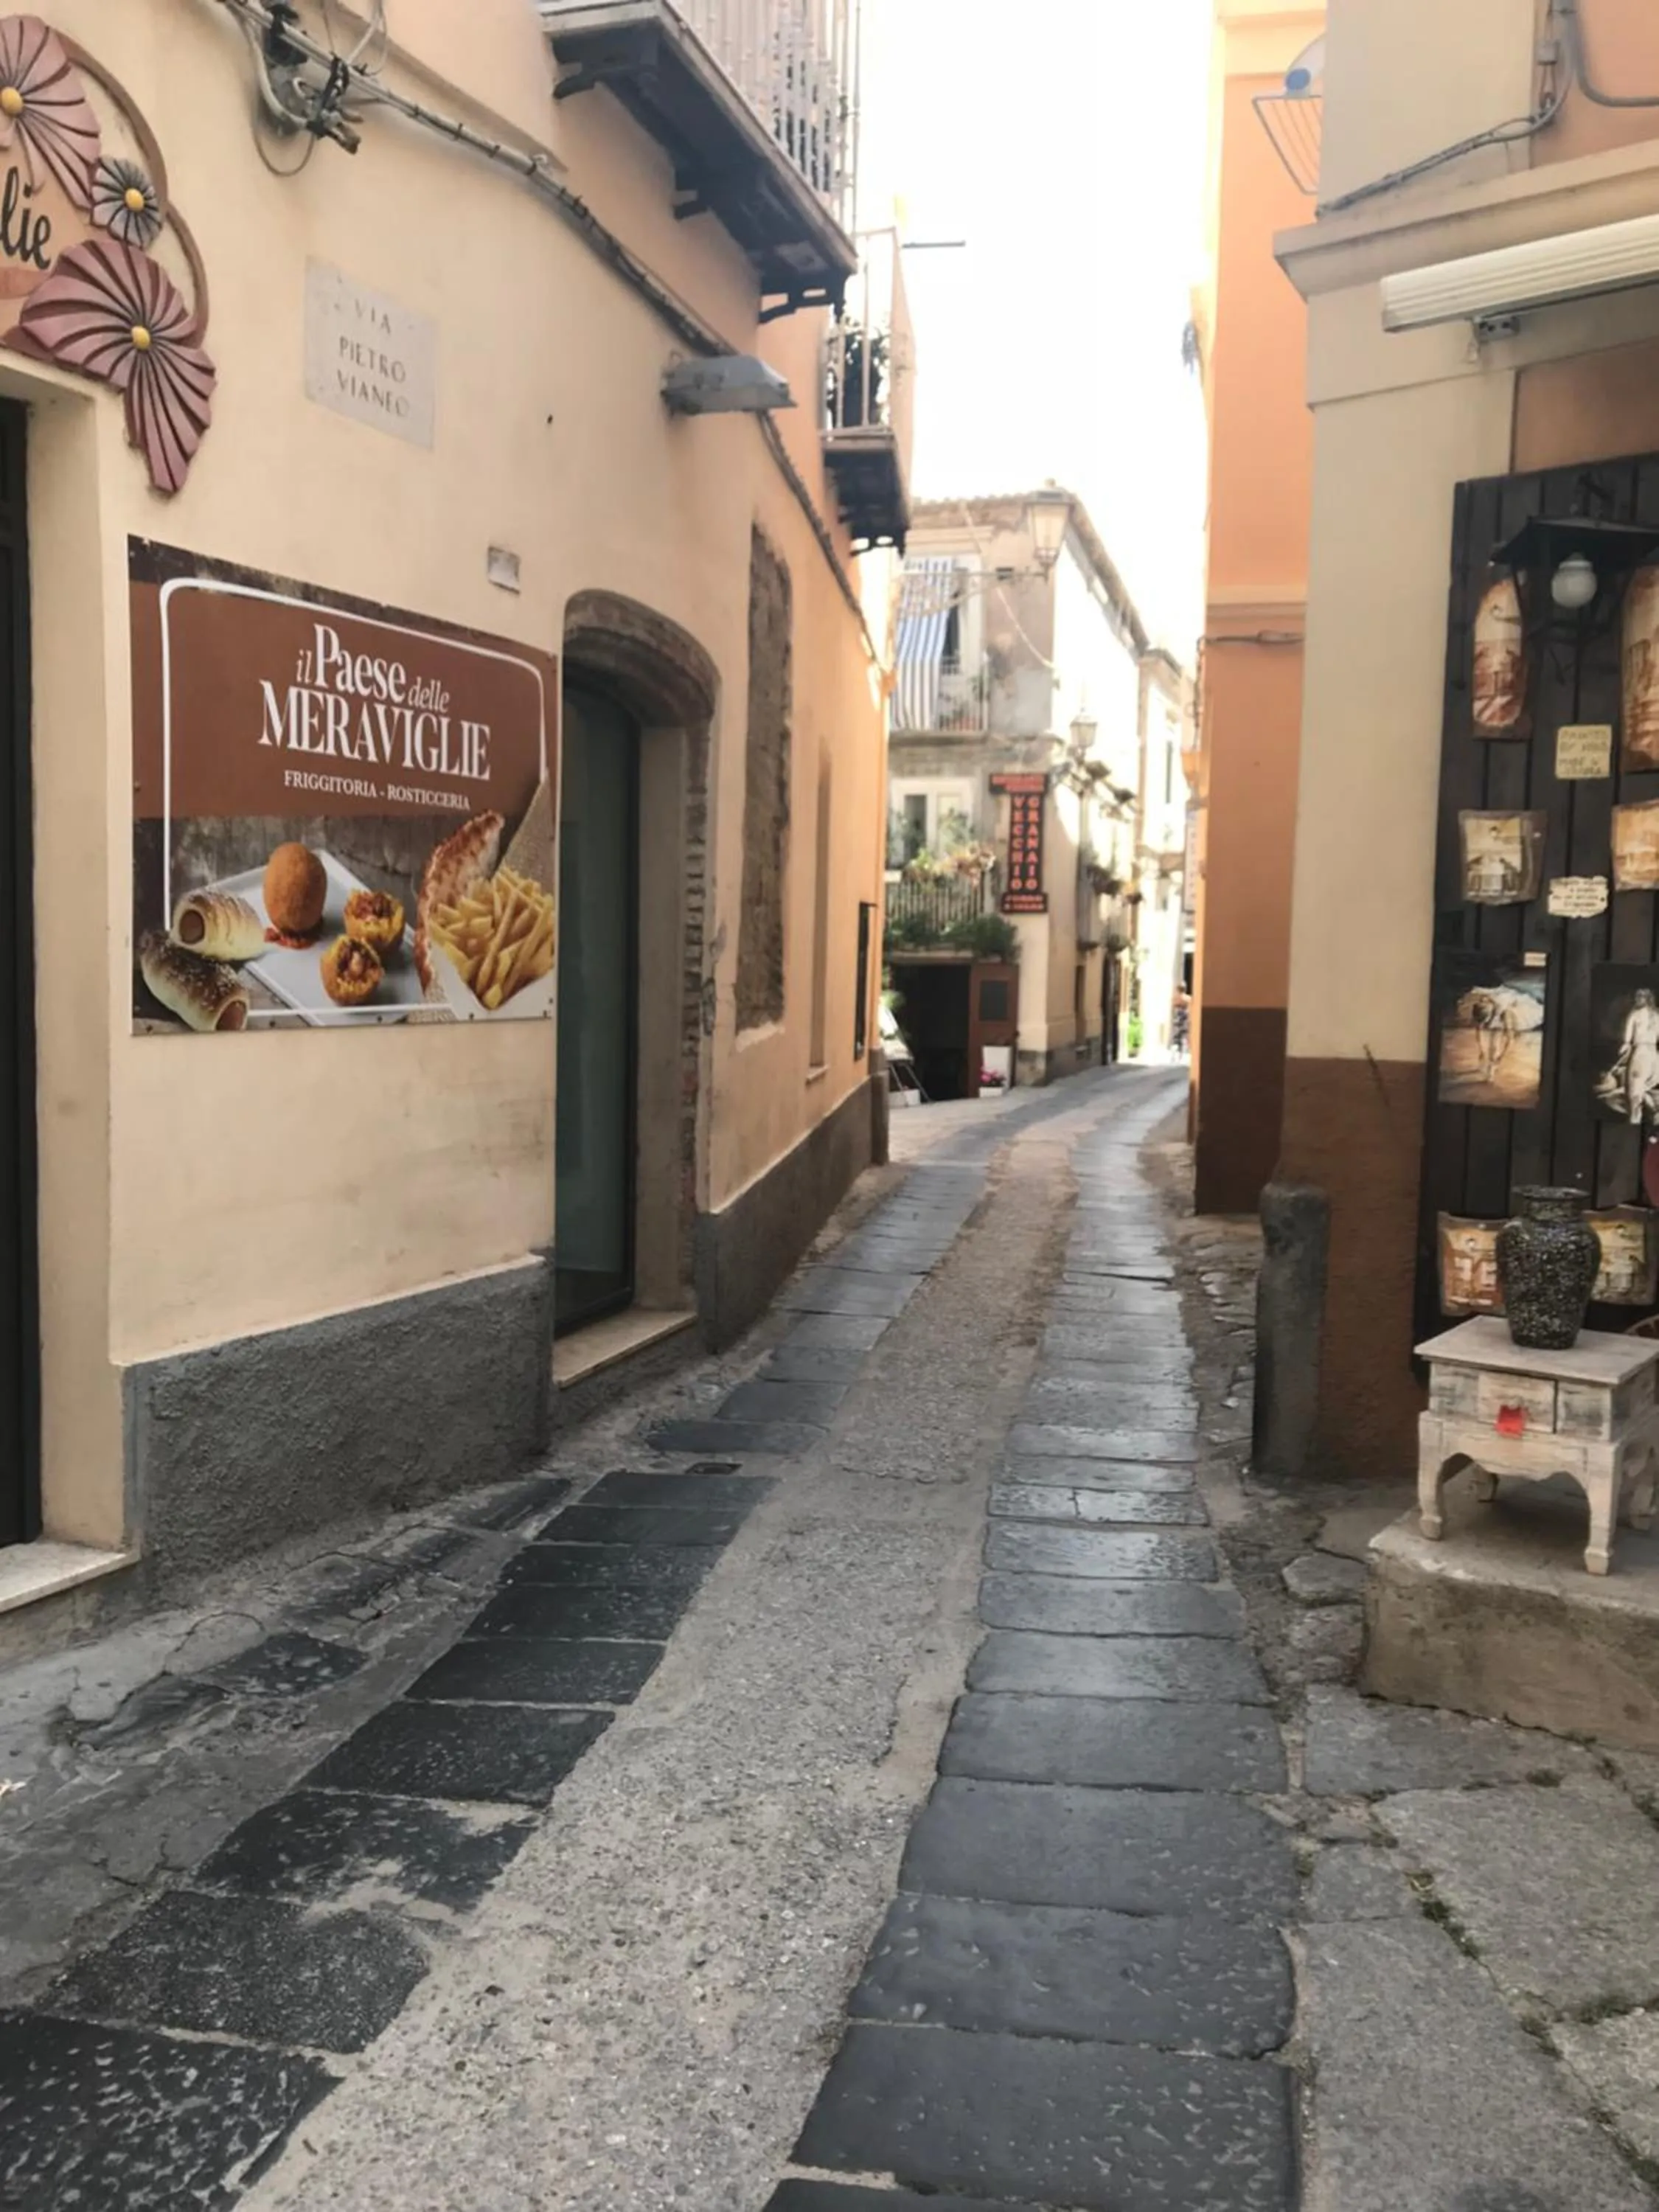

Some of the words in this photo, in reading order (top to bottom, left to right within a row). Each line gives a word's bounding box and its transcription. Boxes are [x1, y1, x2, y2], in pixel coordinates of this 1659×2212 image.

[354, 297, 392, 335] VIA
[339, 335, 406, 384] PIETRO
[336, 368, 410, 418] VIANEO
[296, 649, 313, 684] il
[313, 623, 407, 704] Paese
[407, 675, 450, 713] delle
[257, 678, 492, 782] MERAVIGLIE
[283, 769, 378, 799] FRIGGITORIA
[386, 784, 471, 810] ROSTICCERIA
